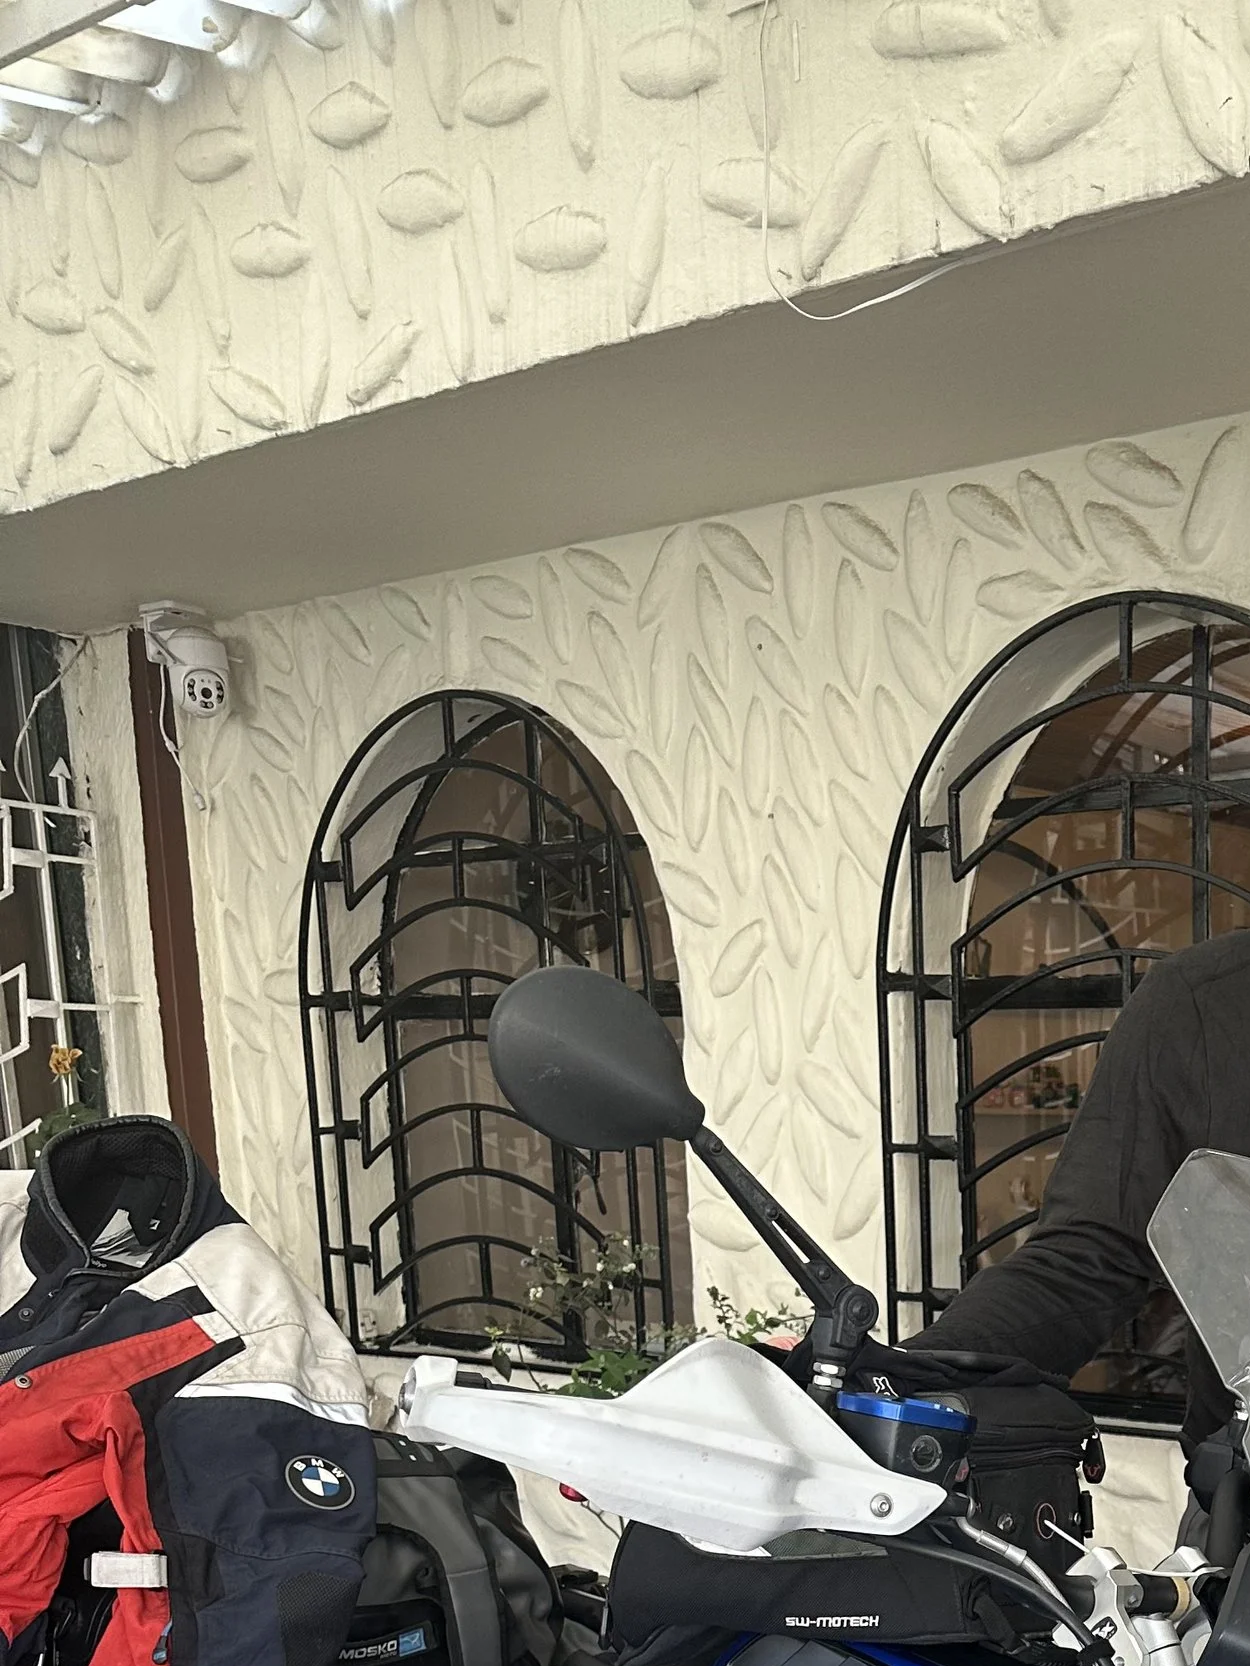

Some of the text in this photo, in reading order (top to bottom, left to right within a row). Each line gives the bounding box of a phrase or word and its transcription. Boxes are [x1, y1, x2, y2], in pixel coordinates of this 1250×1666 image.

[292, 1457, 345, 1479] BMW
[784, 1615, 880, 1628] SW-MOTECH
[338, 1639, 398, 1660] MOSKO
